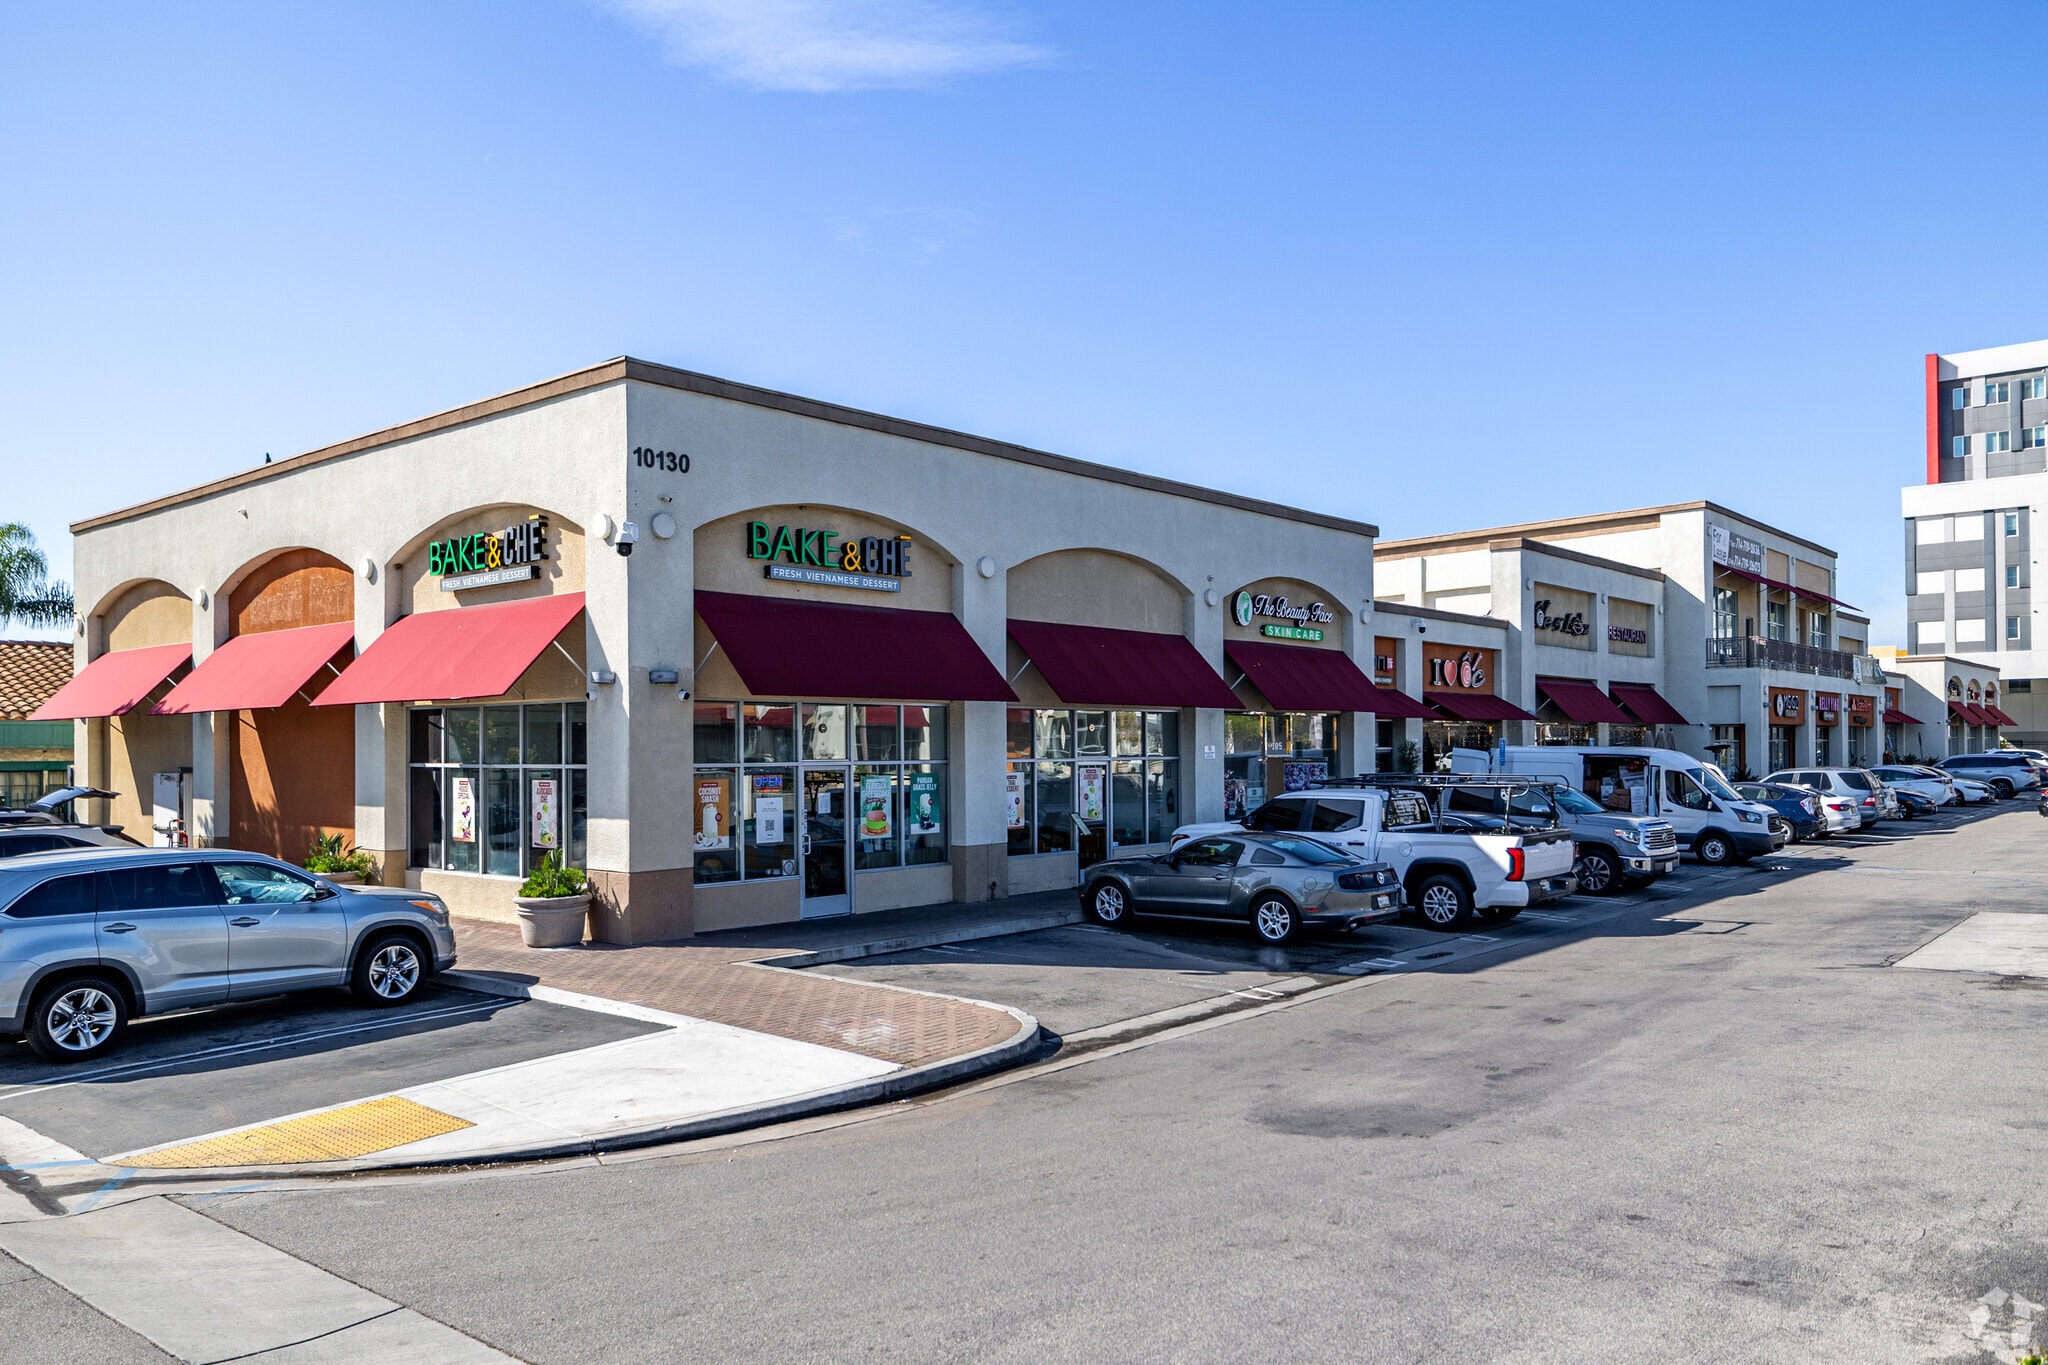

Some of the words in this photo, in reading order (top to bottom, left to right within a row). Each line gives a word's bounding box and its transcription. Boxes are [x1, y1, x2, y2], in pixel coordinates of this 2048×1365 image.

[633, 446, 690, 474] 10130
[429, 532, 486, 576] BAKE
[488, 537, 501, 568] &
[752, 521, 839, 568] BAKE
[843, 541, 862, 571] &
[442, 577, 460, 590] FRESH
[462, 572, 500, 588] VIETNAMESE
[502, 568, 529, 581] DESSERT
[773, 568, 802, 579] FRESH
[806, 571, 859, 586] VIETNAMESE
[863, 578, 898, 590] DESSERT
[1253, 594, 1275, 616] The
[1276, 596, 1310, 627] Beauty
[1311, 602, 1333, 623] Face
[1268, 626, 1292, 638] SKIN
[1295, 629, 1321, 640] CARE
[1608, 626, 1647, 644] RESTAURANT
[1433, 658, 1441, 686] I
[698, 787, 722, 796] COCONUT
[754, 776, 782, 787] OPEN
[701, 795, 720, 803] SMASH
